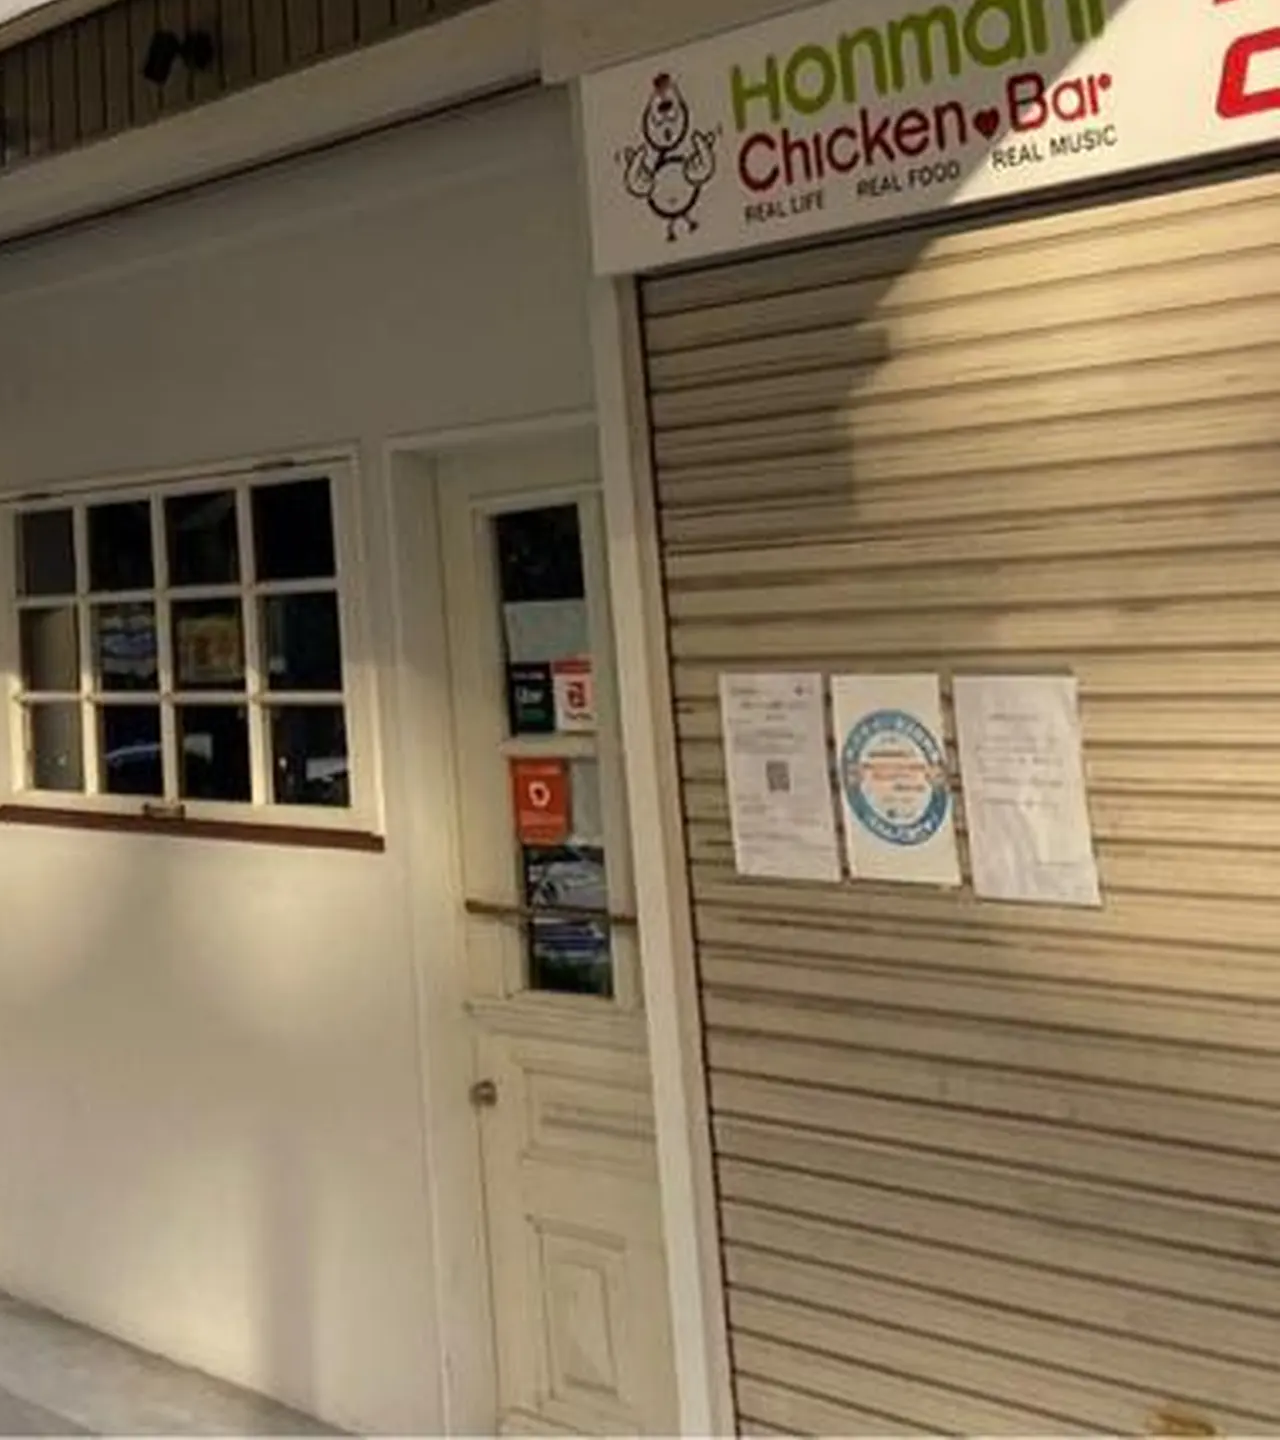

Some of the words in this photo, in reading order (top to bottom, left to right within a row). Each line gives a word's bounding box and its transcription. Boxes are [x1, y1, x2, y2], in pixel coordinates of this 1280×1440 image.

[744, 201, 788, 225] REAL
[790, 189, 826, 215] LIFE
[856, 171, 903, 197] REAL
[907, 161, 961, 189] FOOD
[991, 143, 1042, 170] REAL
[1048, 124, 1118, 158] MUSIC
